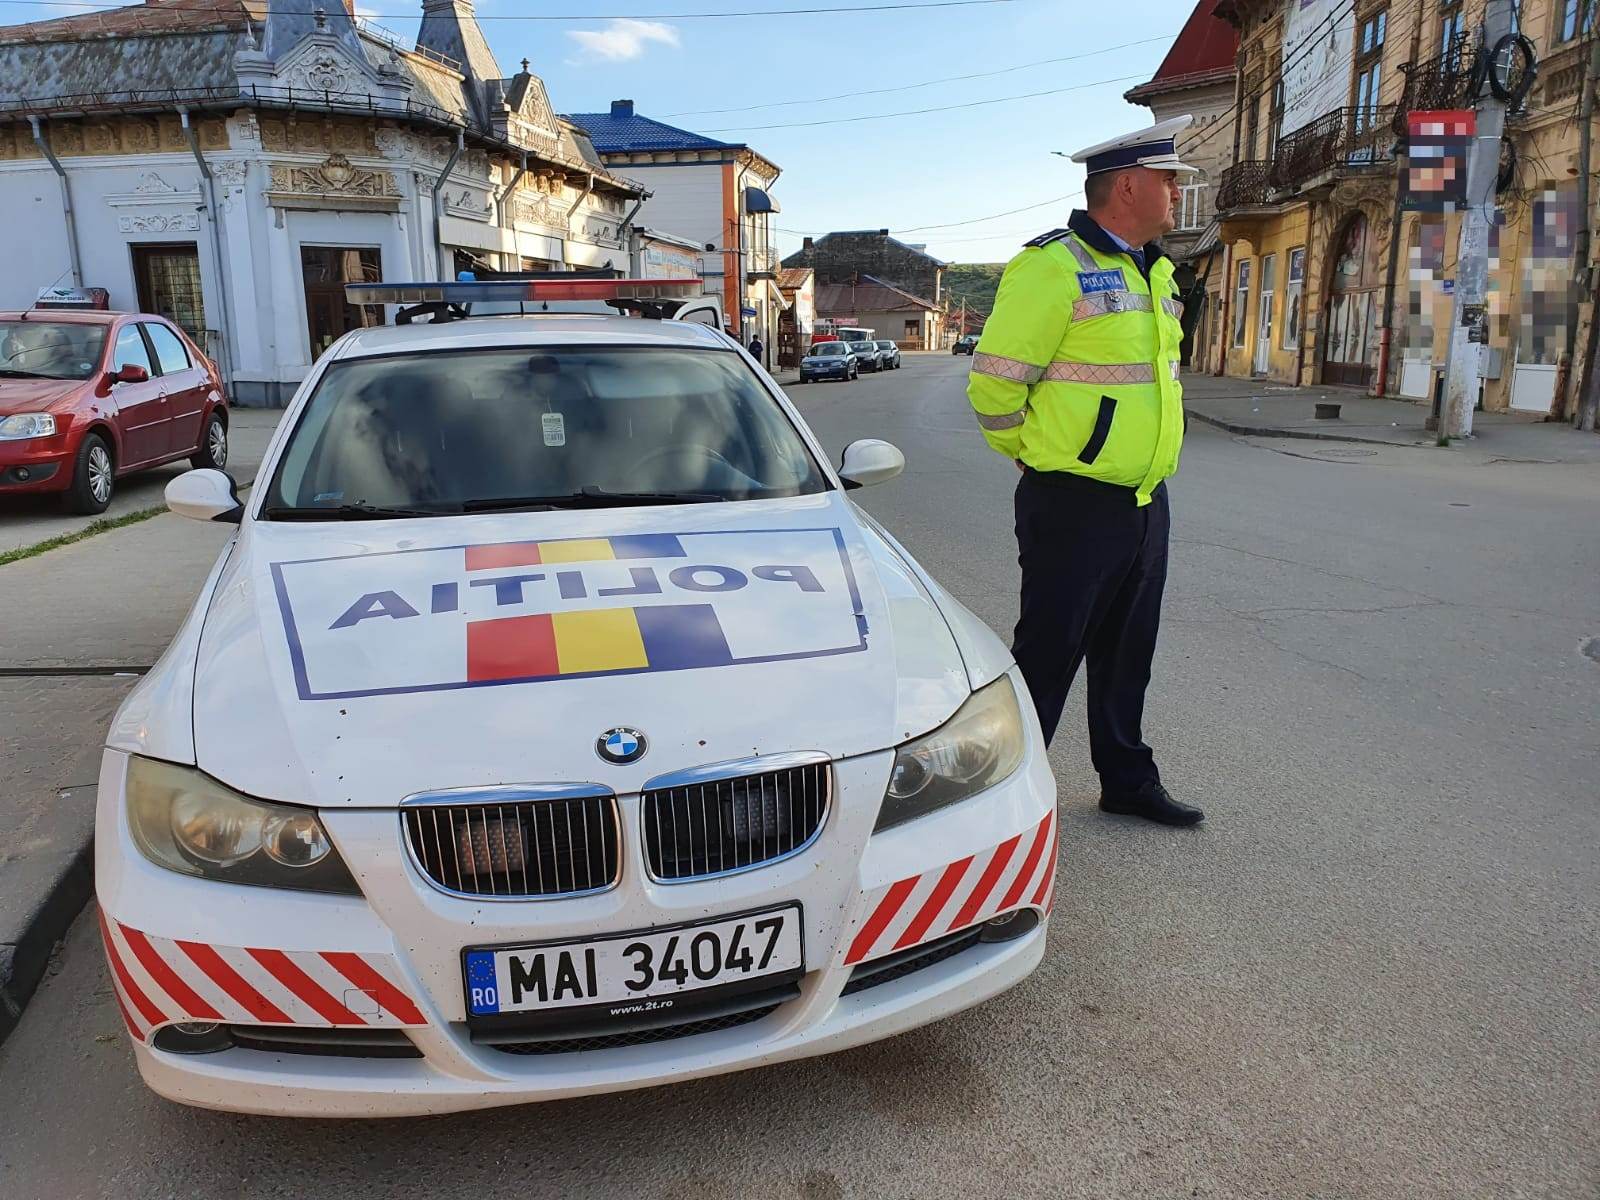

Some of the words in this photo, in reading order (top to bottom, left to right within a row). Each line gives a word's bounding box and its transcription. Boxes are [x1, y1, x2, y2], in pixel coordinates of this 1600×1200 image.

[600, 728, 641, 740] BMW
[508, 948, 598, 1004] MAI
[622, 916, 784, 992] 34047
[472, 987, 496, 1007] RO
[610, 1000, 674, 1016] www.2t.ro
